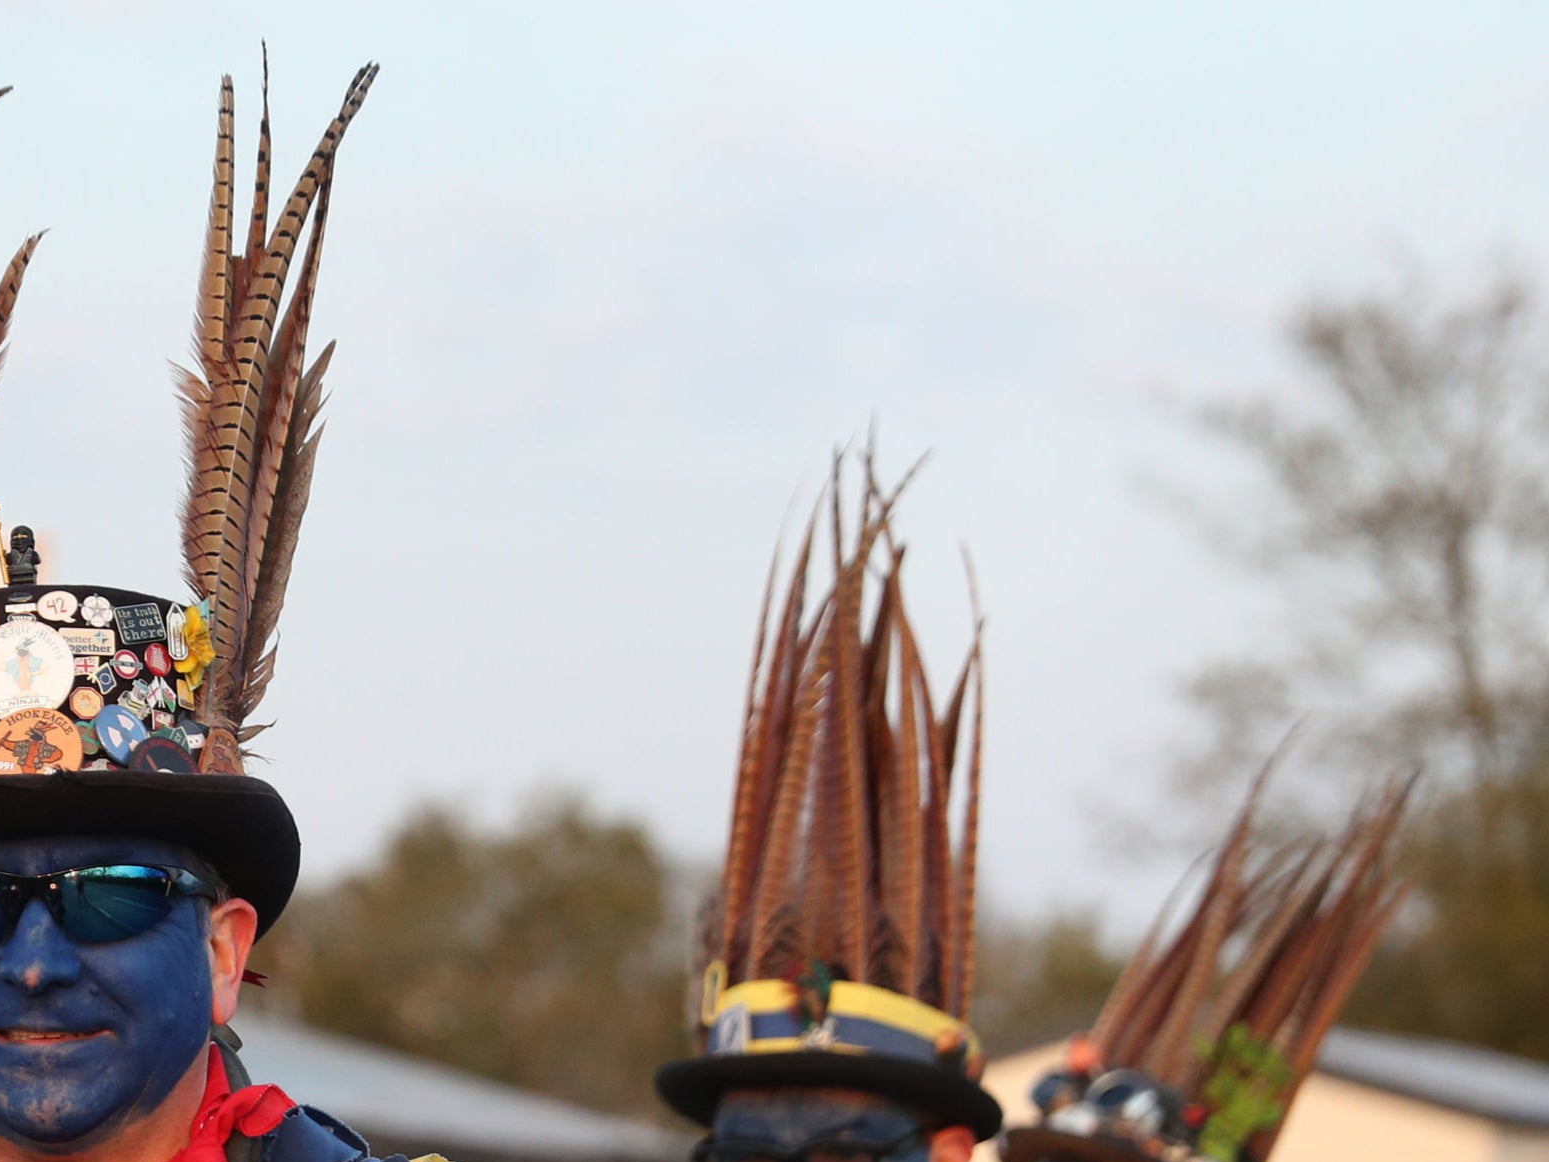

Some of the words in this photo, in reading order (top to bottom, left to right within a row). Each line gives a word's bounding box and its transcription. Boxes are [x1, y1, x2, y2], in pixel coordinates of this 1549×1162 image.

[46, 597, 67, 614] 42
[117, 609, 132, 619] the
[134, 606, 158, 617] truth
[120, 621, 135, 629] is
[138, 617, 162, 627] out
[124, 629, 164, 641] there
[68, 643, 112, 653] ogether
[8, 698, 41, 707] NINJA
[6, 709, 40, 726] HOOK
[41, 711, 74, 736] EAGLE
